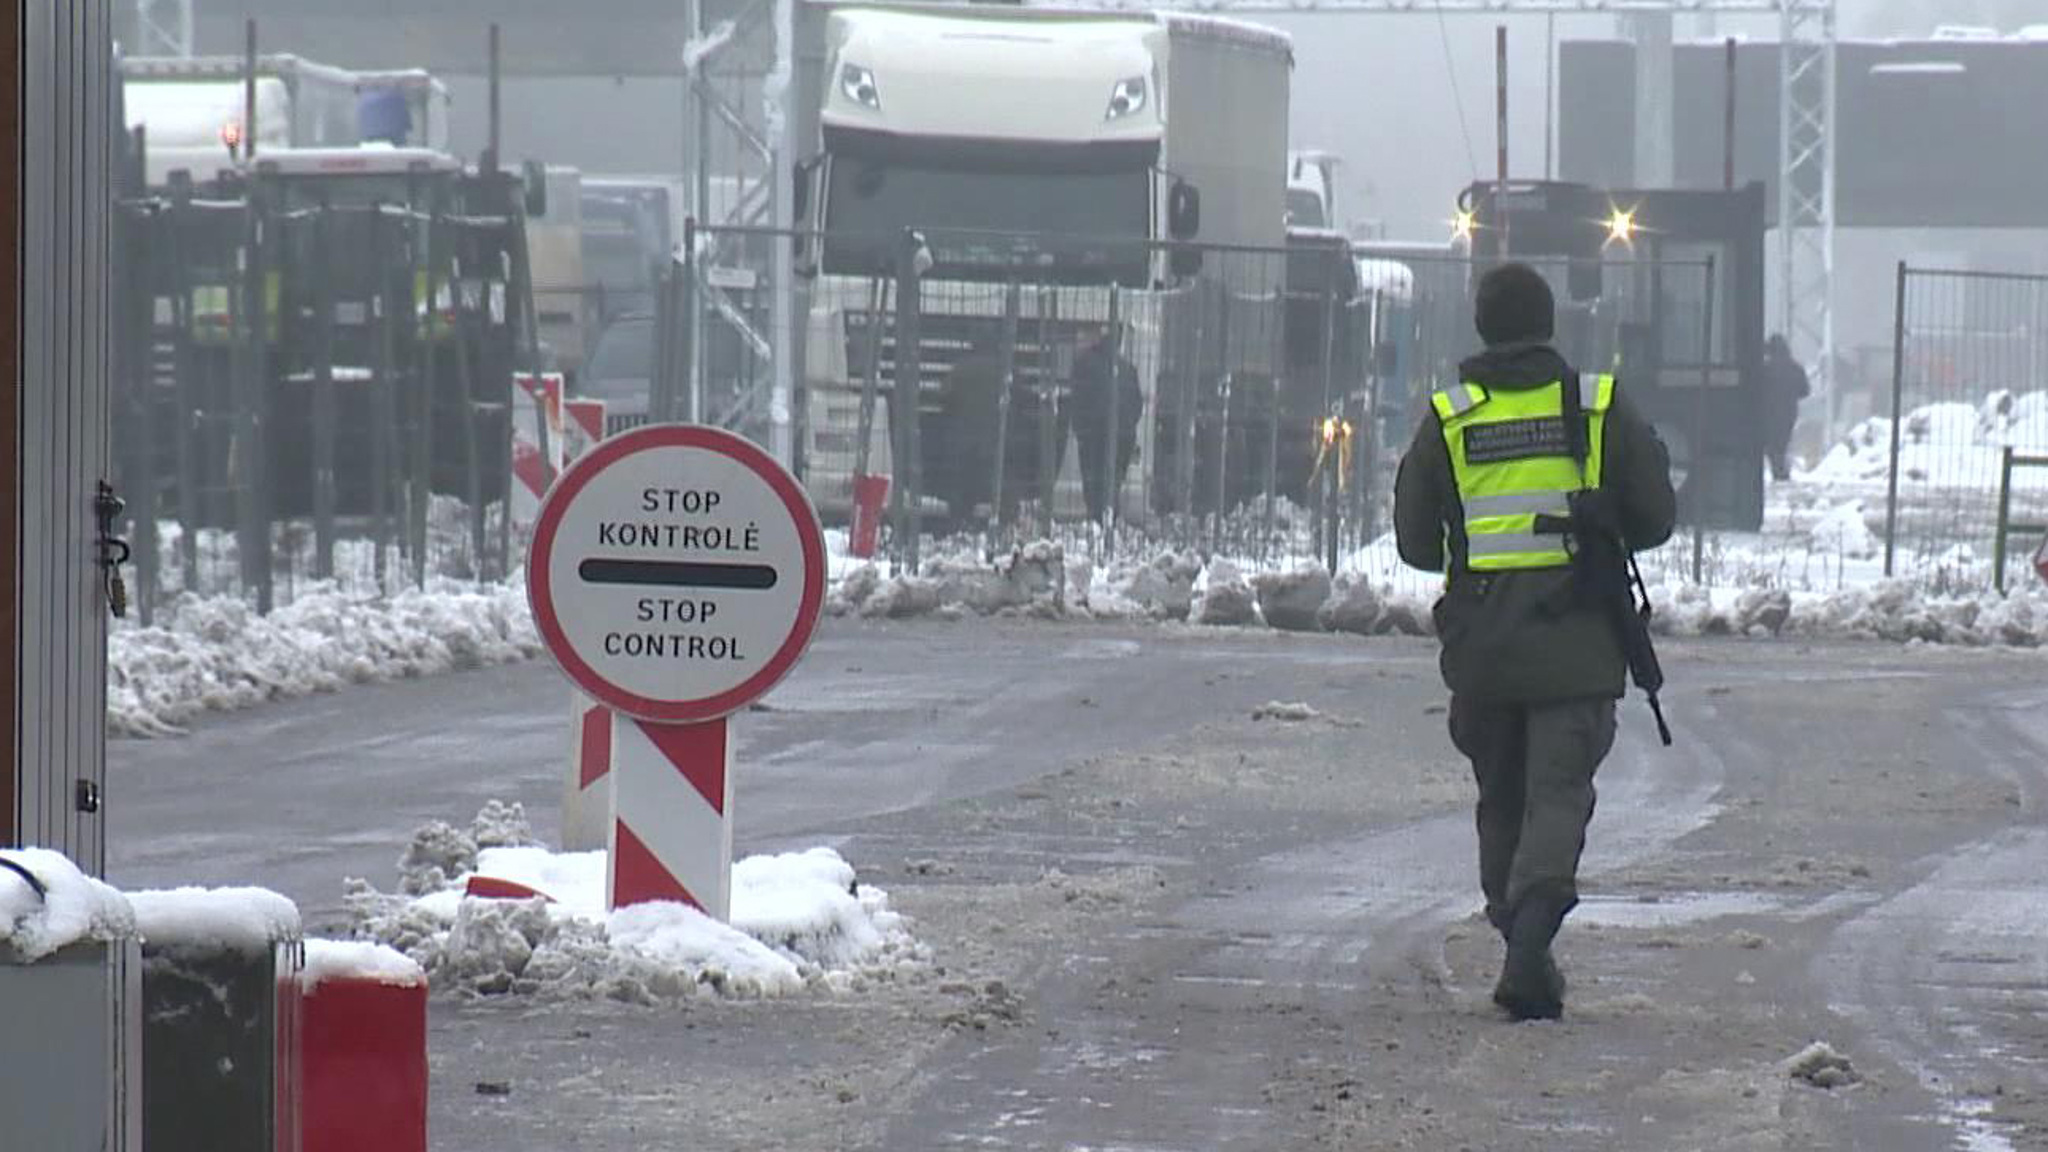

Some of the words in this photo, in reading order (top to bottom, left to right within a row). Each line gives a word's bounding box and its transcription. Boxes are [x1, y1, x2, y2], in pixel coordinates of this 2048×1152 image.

[643, 488, 720, 514] STOP
[599, 521, 759, 551] KONTROLĖ
[637, 599, 717, 624] STOP
[604, 632, 745, 660] CONTROL
